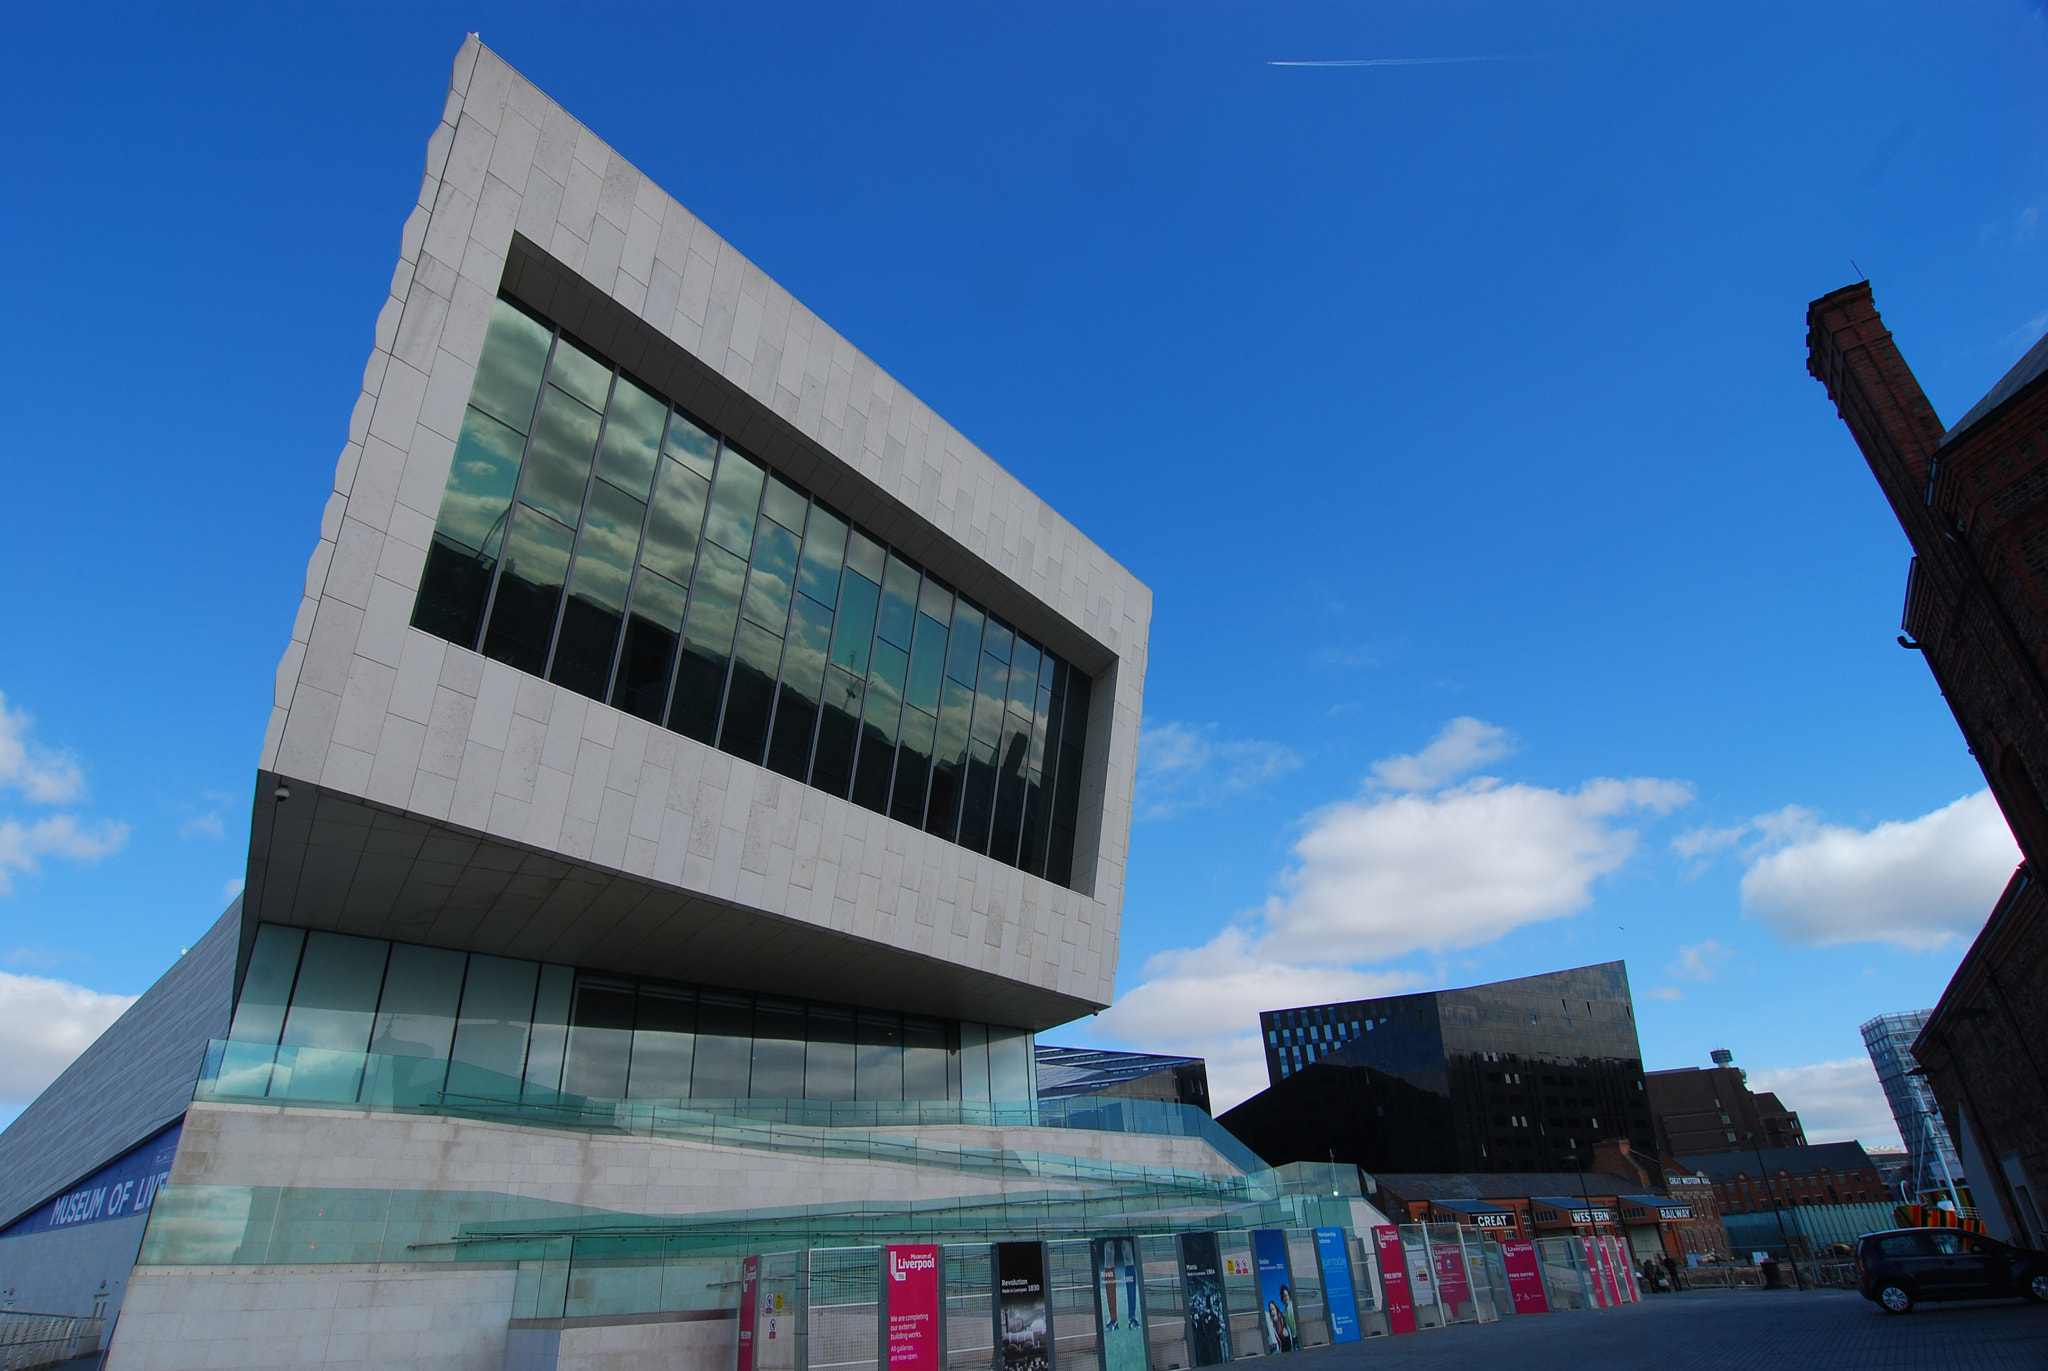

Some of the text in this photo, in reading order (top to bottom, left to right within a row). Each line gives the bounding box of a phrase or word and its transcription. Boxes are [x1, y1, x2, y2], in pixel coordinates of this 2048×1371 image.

[49, 1186, 108, 1226] MUSEUM
[108, 1180, 134, 1215] OF
[1477, 1215, 1507, 1227] GREAT
[1660, 1208, 1690, 1219] RAILWAY
[1507, 1244, 1533, 1253] Liverpool
[898, 1257, 935, 1271] Liverpool
[1001, 1278, 1028, 1287] Revolution
[1027, 1284, 1040, 1292] 1830
[905, 1313, 929, 1322] completing
[898, 1322, 917, 1331] external
[890, 1332, 908, 1341] building
